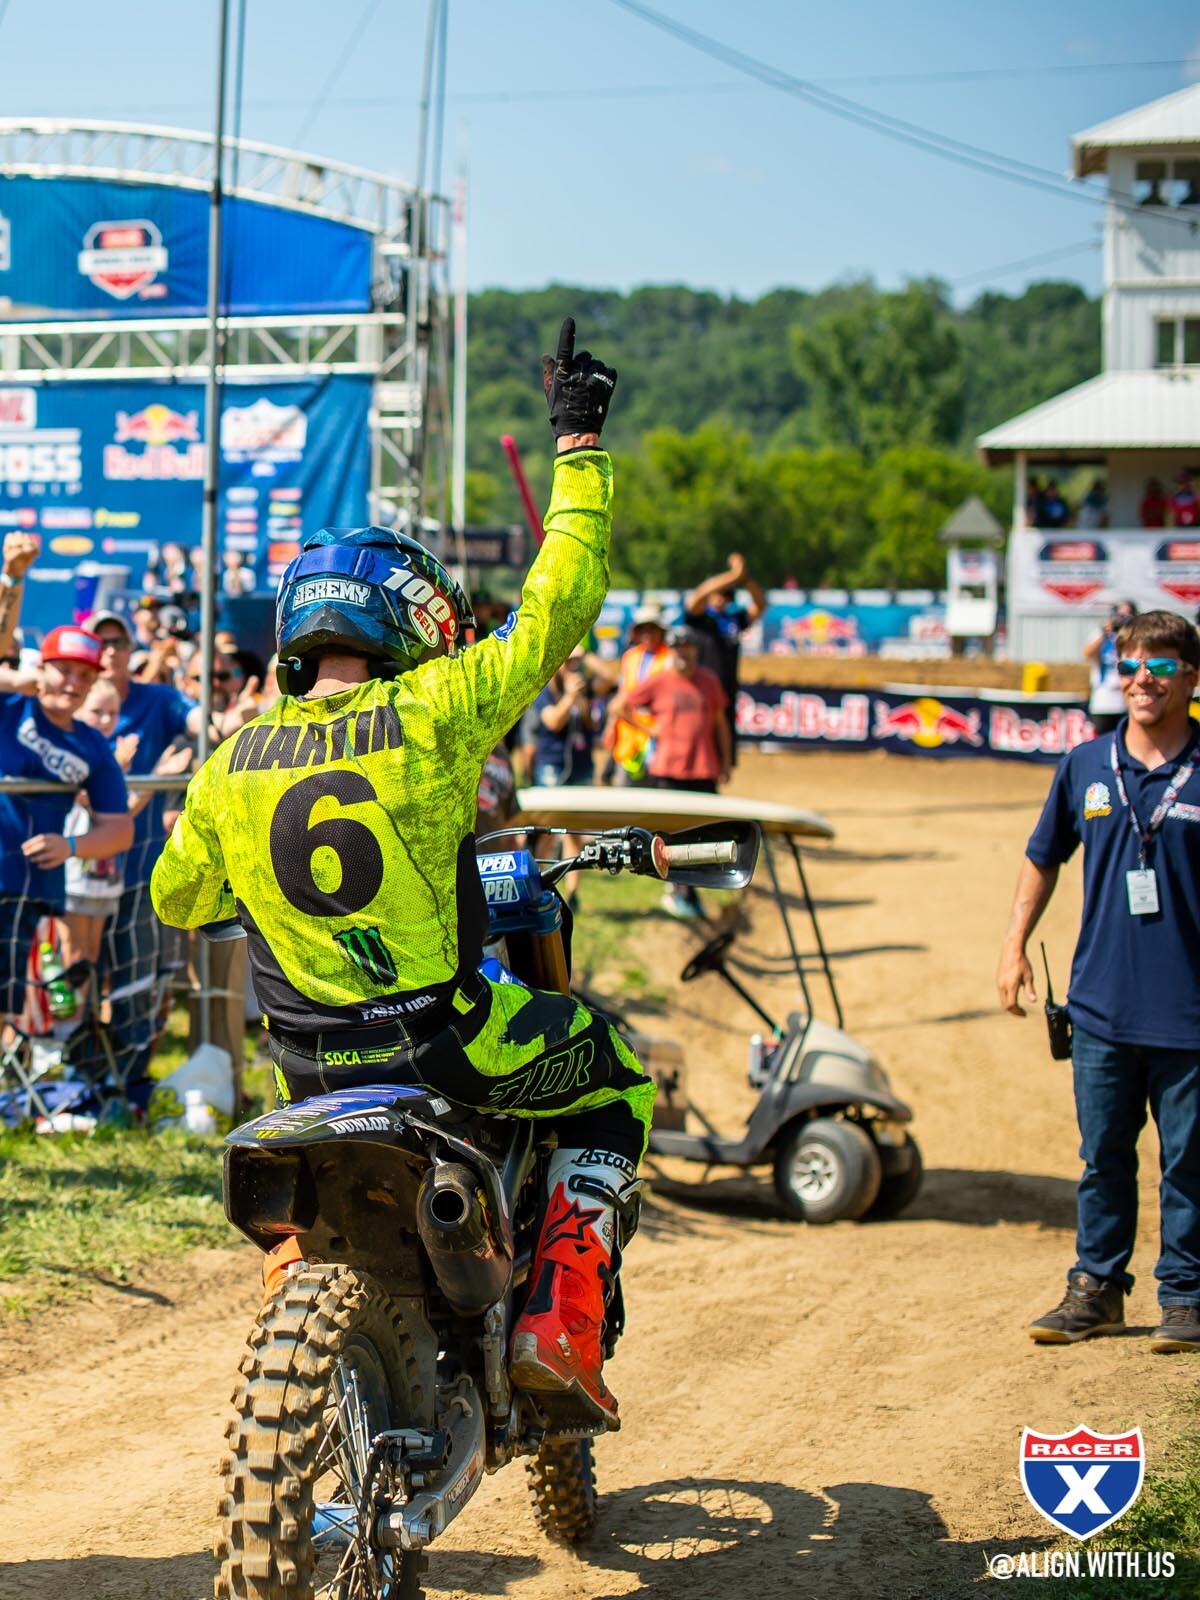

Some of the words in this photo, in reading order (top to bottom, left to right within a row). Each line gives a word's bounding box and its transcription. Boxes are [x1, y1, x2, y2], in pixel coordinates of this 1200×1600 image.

[293, 578, 371, 610] JEREMY
[413, 607, 435, 642] BELL
[736, 693, 793, 737] Red
[797, 693, 869, 743] Bull
[989, 707, 1063, 754] Red
[228, 702, 403, 776] MARTIN
[269, 769, 384, 918] 6
[476, 855, 514, 873] APER
[483, 878, 515, 902] PER
[324, 1051, 361, 1066] SDCA
[327, 1116, 390, 1135] DUNLOP
